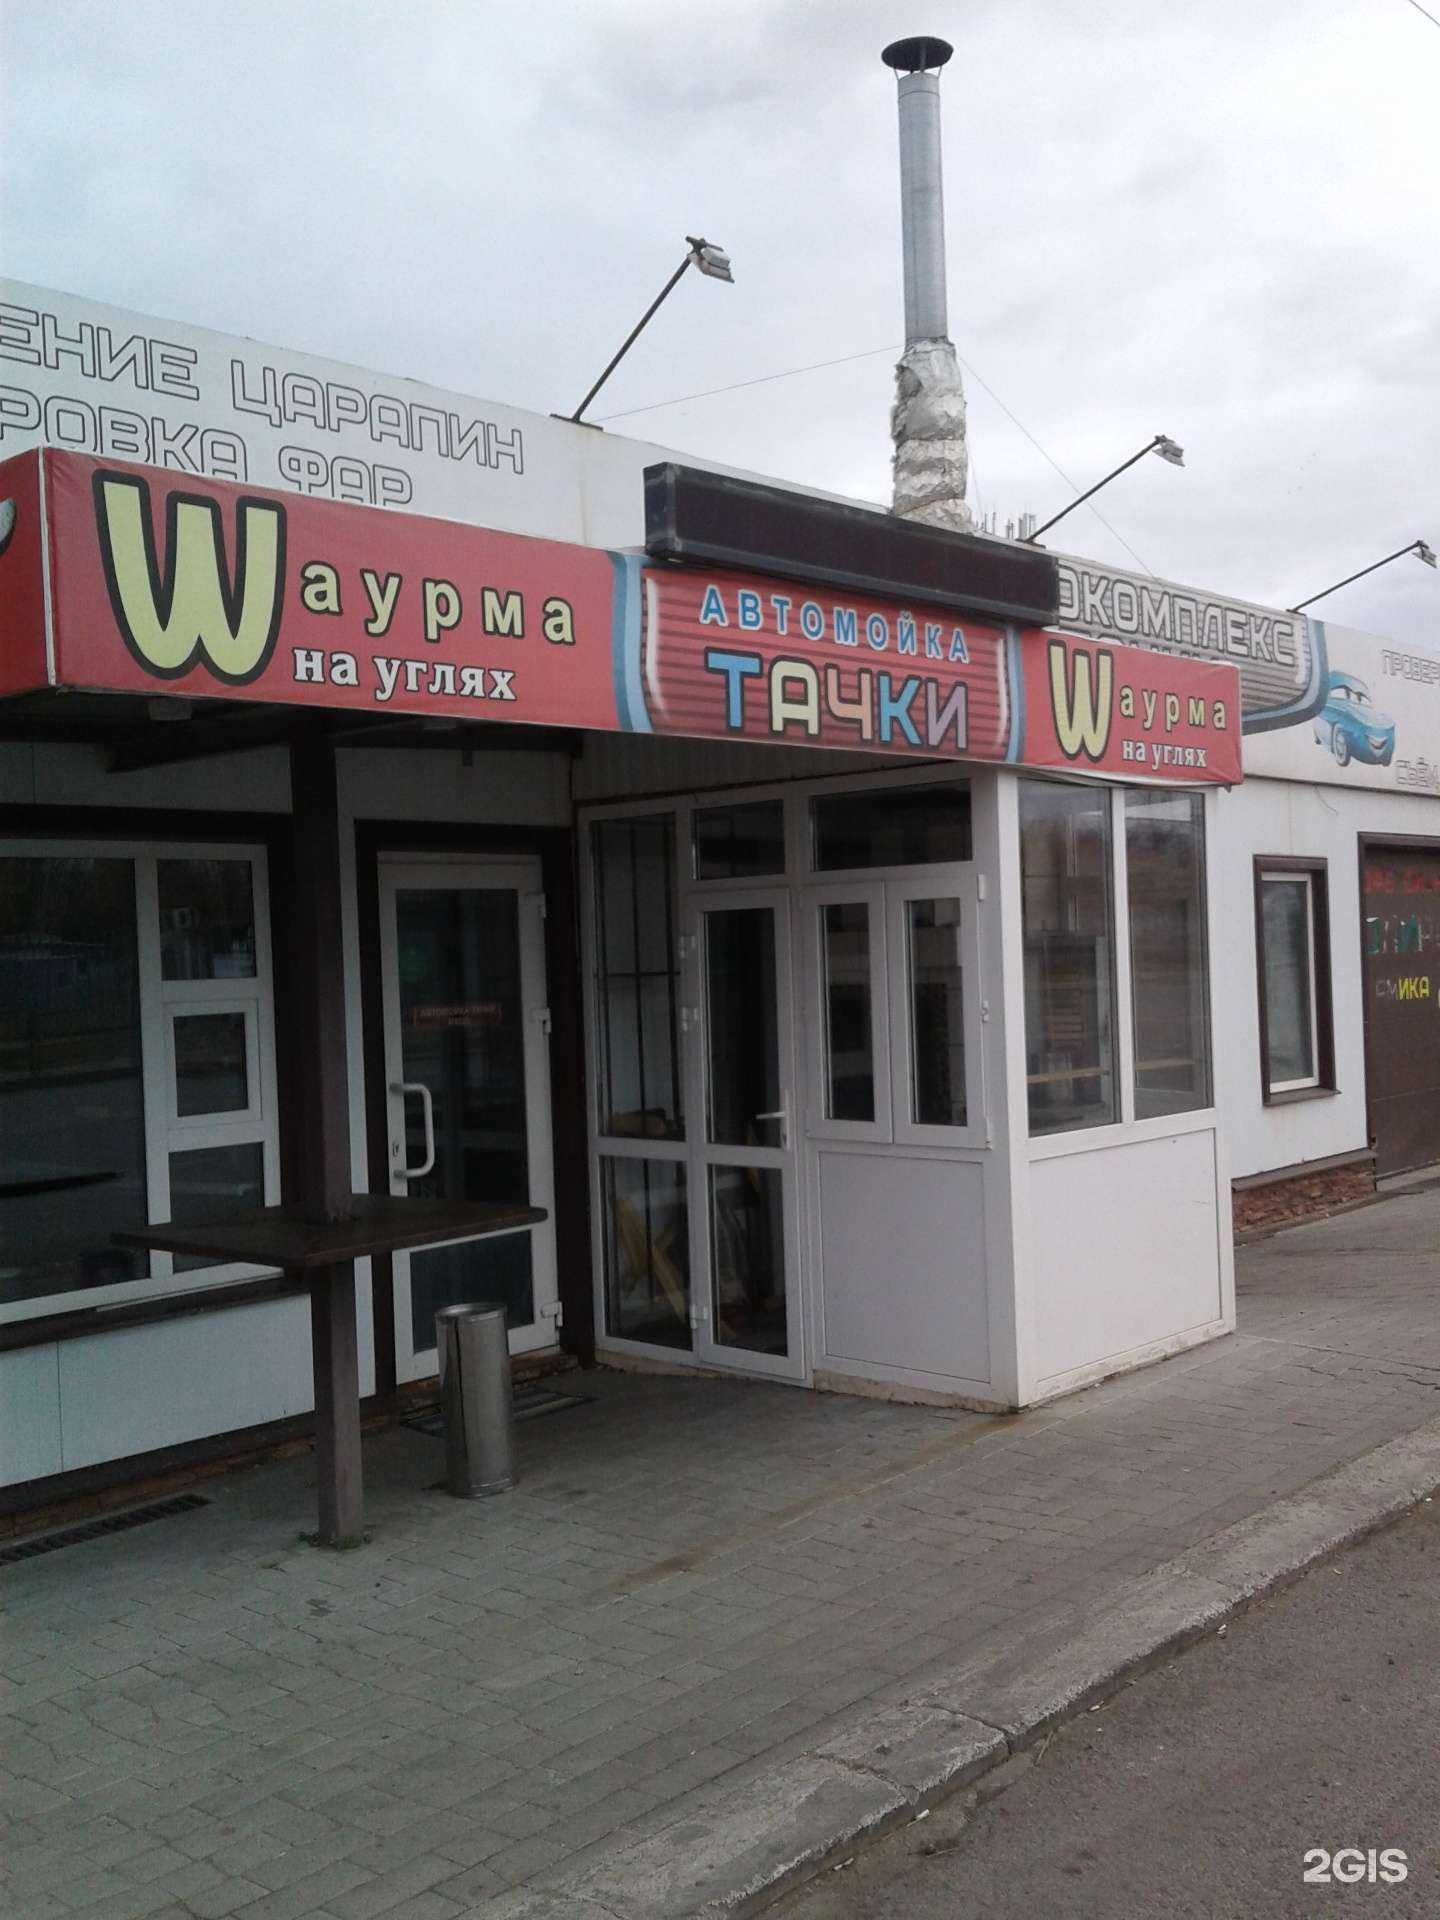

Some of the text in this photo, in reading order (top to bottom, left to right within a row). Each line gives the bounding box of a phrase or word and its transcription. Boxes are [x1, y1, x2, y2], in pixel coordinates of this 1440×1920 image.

[231, 359, 524, 475] ЦАРАПИН
[278, 445, 412, 506] ФАР
[700, 584, 971, 664] АВТОМОЙКА
[293, 646, 517, 702] на углях
[704, 646, 968, 751] ТАЧКИ
[1121, 737, 1207, 771] на углях
